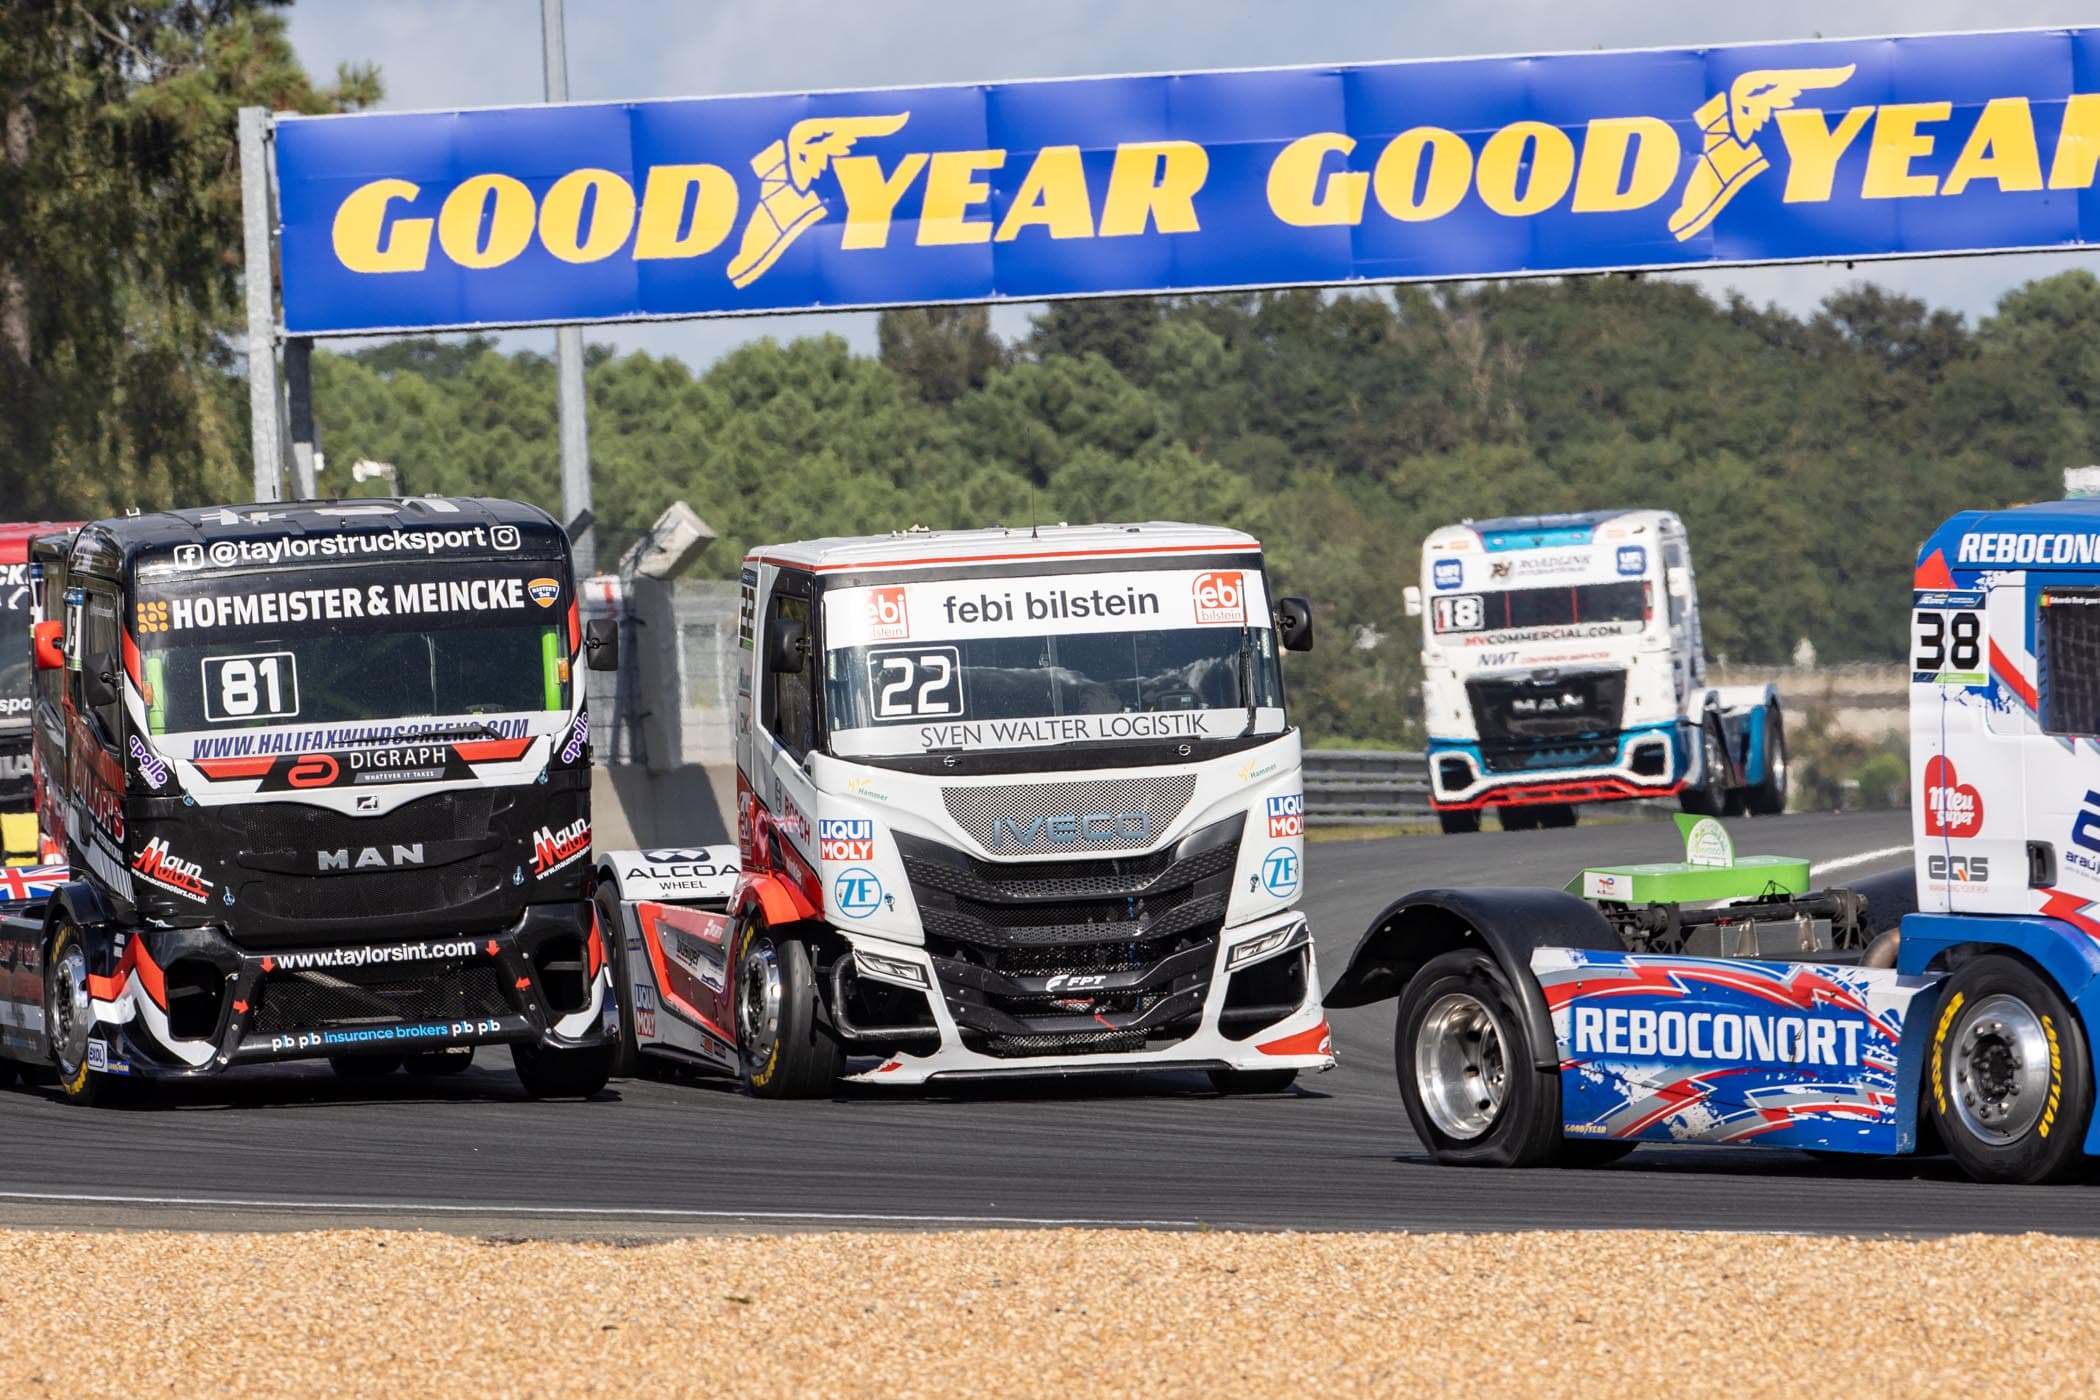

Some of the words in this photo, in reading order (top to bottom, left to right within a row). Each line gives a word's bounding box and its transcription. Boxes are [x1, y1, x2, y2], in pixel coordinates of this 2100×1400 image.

[333, 140, 1210, 273] GOODYEAR
[209, 526, 487, 566] @taylorstrucksport
[172, 587, 364, 630] HOFMEISTER
[367, 586, 391, 616] &
[395, 578, 525, 614] MEINCKE
[1192, 572, 1243, 608] febi
[943, 591, 1014, 624] febi
[1027, 586, 1160, 620] bilstein
[1201, 609, 1242, 621] bilstein
[1437, 597, 1479, 630] 18
[1465, 626, 1623, 646] MVCOMMERCIAL.COM
[1916, 612, 1980, 670] 38
[1478, 651, 1519, 667] NWT
[221, 657, 281, 716] 81
[880, 655, 951, 716] 22
[921, 724, 982, 748] SVEN
[990, 718, 1090, 743] WALTER
[1099, 713, 1208, 737] LOGISTIK
[130, 735, 167, 785] apollo
[350, 747, 447, 769] DIGRAPH
[1269, 795, 1303, 817] LIQU
[1929, 786, 1975, 811] Meu
[820, 821, 871, 840] LIQUI
[991, 811, 1151, 848] IVECO
[1936, 810, 1975, 829] super
[317, 843, 425, 871] MAN
[822, 841, 873, 860] MOLY
[625, 864, 741, 880] ALCOA
[659, 881, 708, 890] WHEEL
[1269, 857, 1296, 888] ZF
[842, 879, 873, 908] ZF
[278, 941, 476, 969] www.taylorsint.com
[1067, 975, 1106, 986] FPT
[635, 985, 654, 1010] LIQUI
[272, 1034, 295, 1051] pib
[299, 1031, 321, 1049] pib
[324, 1029, 393, 1044] insurance
[395, 1023, 448, 1038] brokers
[452, 1021, 474, 1037] pib
[478, 1019, 501, 1035] pib
[637, 1011, 656, 1037] MOLY
[1575, 1007, 1864, 1066] REBOCONORT
